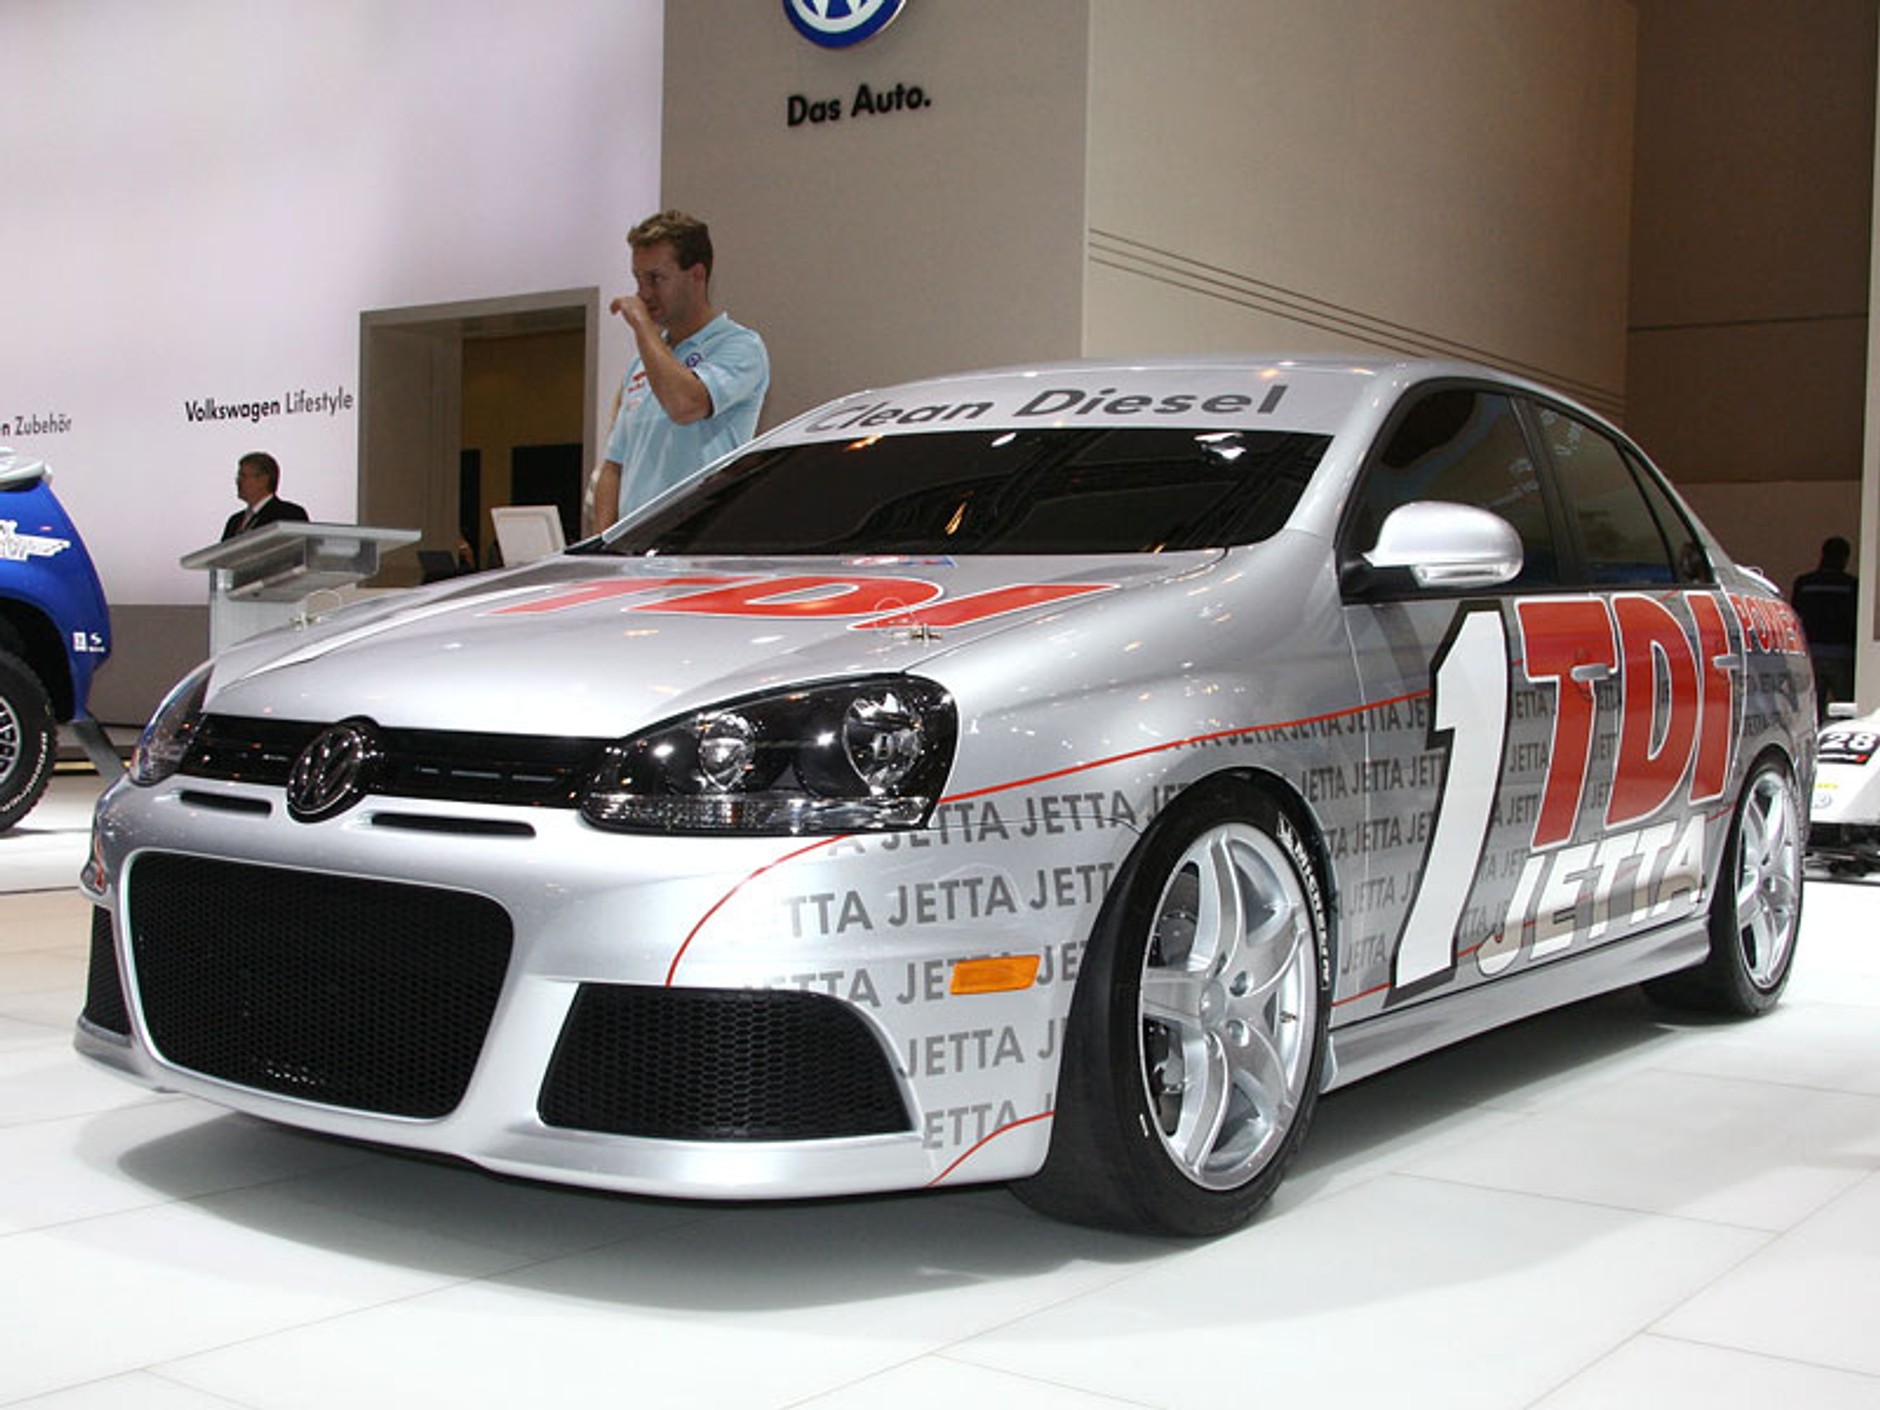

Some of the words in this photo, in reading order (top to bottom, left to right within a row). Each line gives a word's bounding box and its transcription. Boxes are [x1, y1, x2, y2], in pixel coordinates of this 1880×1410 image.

[787, 95, 841, 126] Das
[851, 83, 932, 117] Auto.
[15, 413, 72, 436] Zubehör
[185, 398, 281, 423] Volkswagen
[286, 385, 354, 416] Lifestyle
[805, 400, 994, 434] Clean
[1013, 384, 1288, 418] Diesel
[475, 574, 1123, 631] TDI
[1515, 590, 1734, 850] TDI
[1819, 732, 1877, 753] 28
[1301, 764, 1349, 803] JETTA
[1351, 757, 1405, 795] JETTA
[1388, 602, 1509, 1003] 1
[1021, 789, 1137, 838] JETTA
[1352, 817, 1402, 855] JETTA
[888, 874, 1017, 928] JETTA
[1348, 875, 1395, 917] JETTA
[1474, 812, 1708, 977] JETTA
[1341, 932, 1387, 975] JETTA
[896, 1025, 1025, 1080] JETTA
